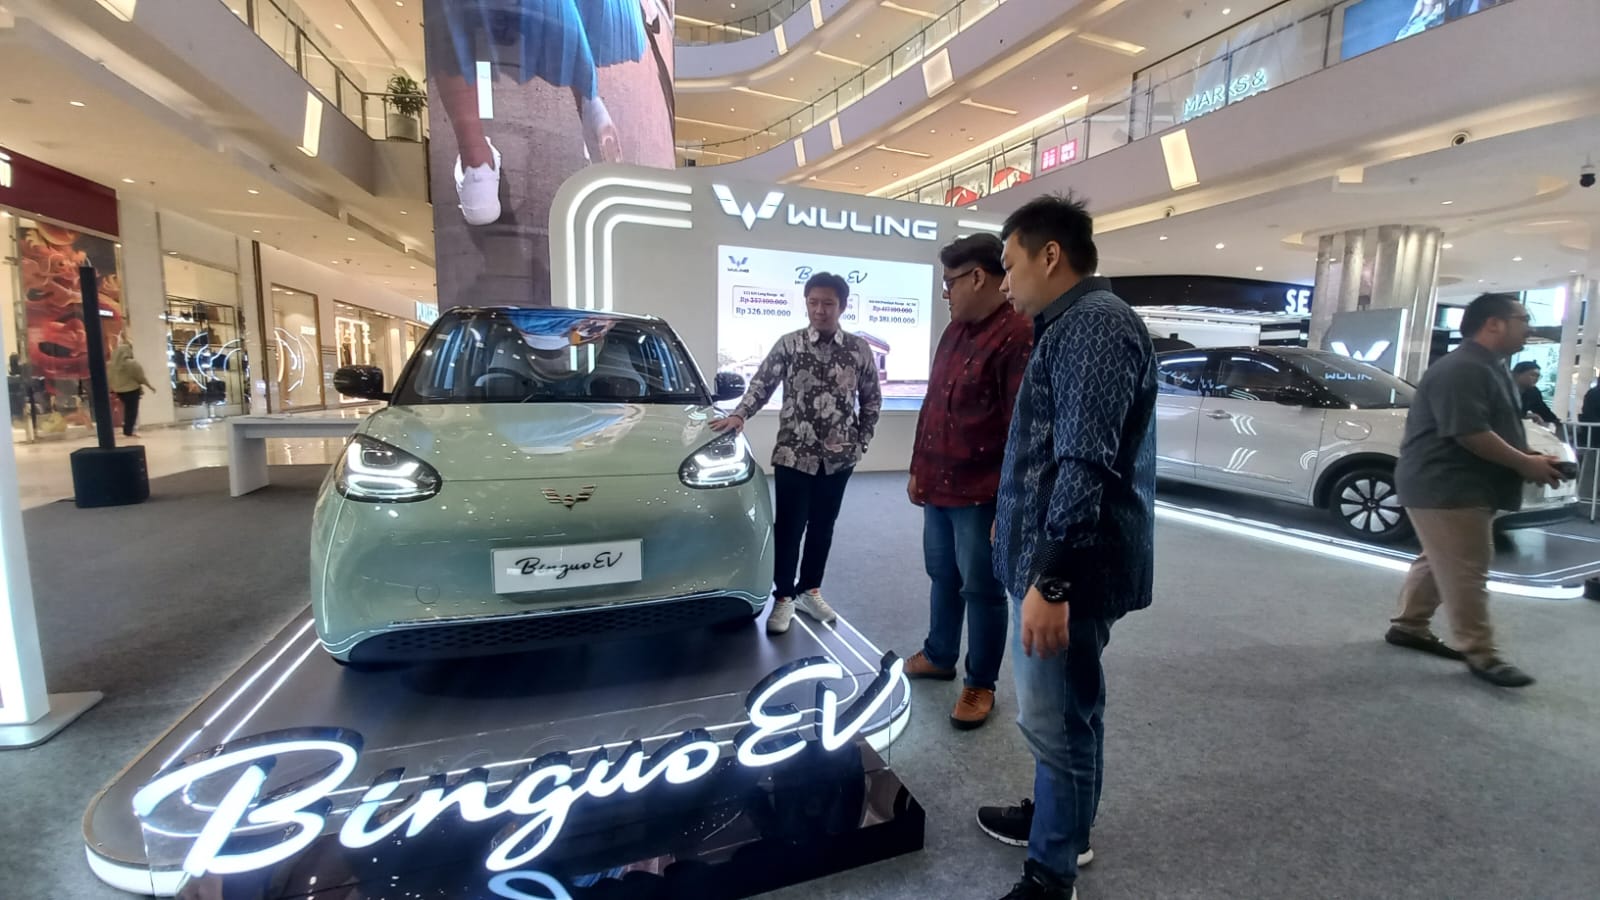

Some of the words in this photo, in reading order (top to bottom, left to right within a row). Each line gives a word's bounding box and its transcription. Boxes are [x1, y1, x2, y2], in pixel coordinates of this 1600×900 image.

[1184, 74, 1250, 116] MARKS
[1251, 68, 1267, 88] &
[788, 204, 938, 241] WULING
[735, 307, 746, 316] Rp
